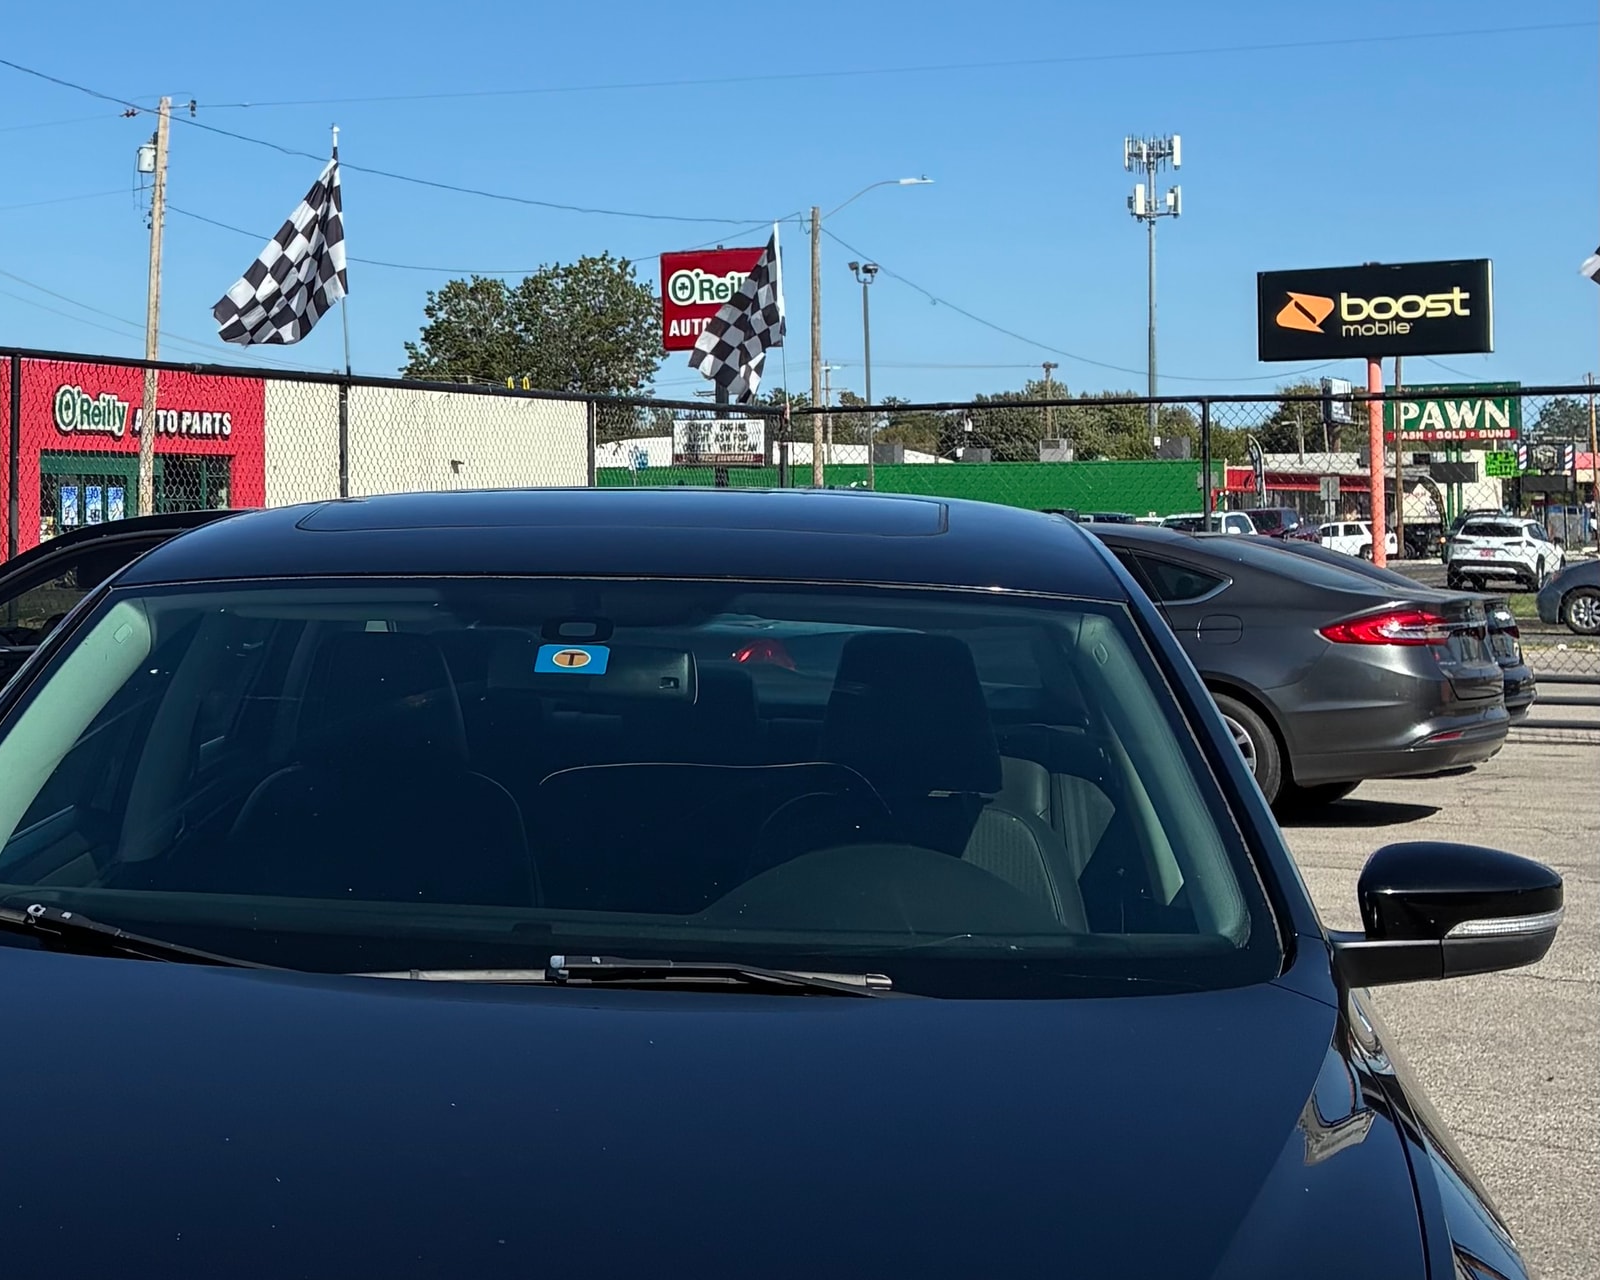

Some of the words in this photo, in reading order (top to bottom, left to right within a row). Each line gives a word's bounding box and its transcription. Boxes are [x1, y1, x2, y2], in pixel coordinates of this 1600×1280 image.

[1340, 286, 1470, 321] boost
[1342, 320, 1411, 337] mobile
[56, 387, 128, 434] O'Reilly
[134, 408, 178, 434] ATO
[181, 411, 232, 436] PARTS
[1393, 400, 1511, 430] PAWN
[1436, 430, 1467, 440] GOLD
[1478, 429, 1511, 439] GUNS
